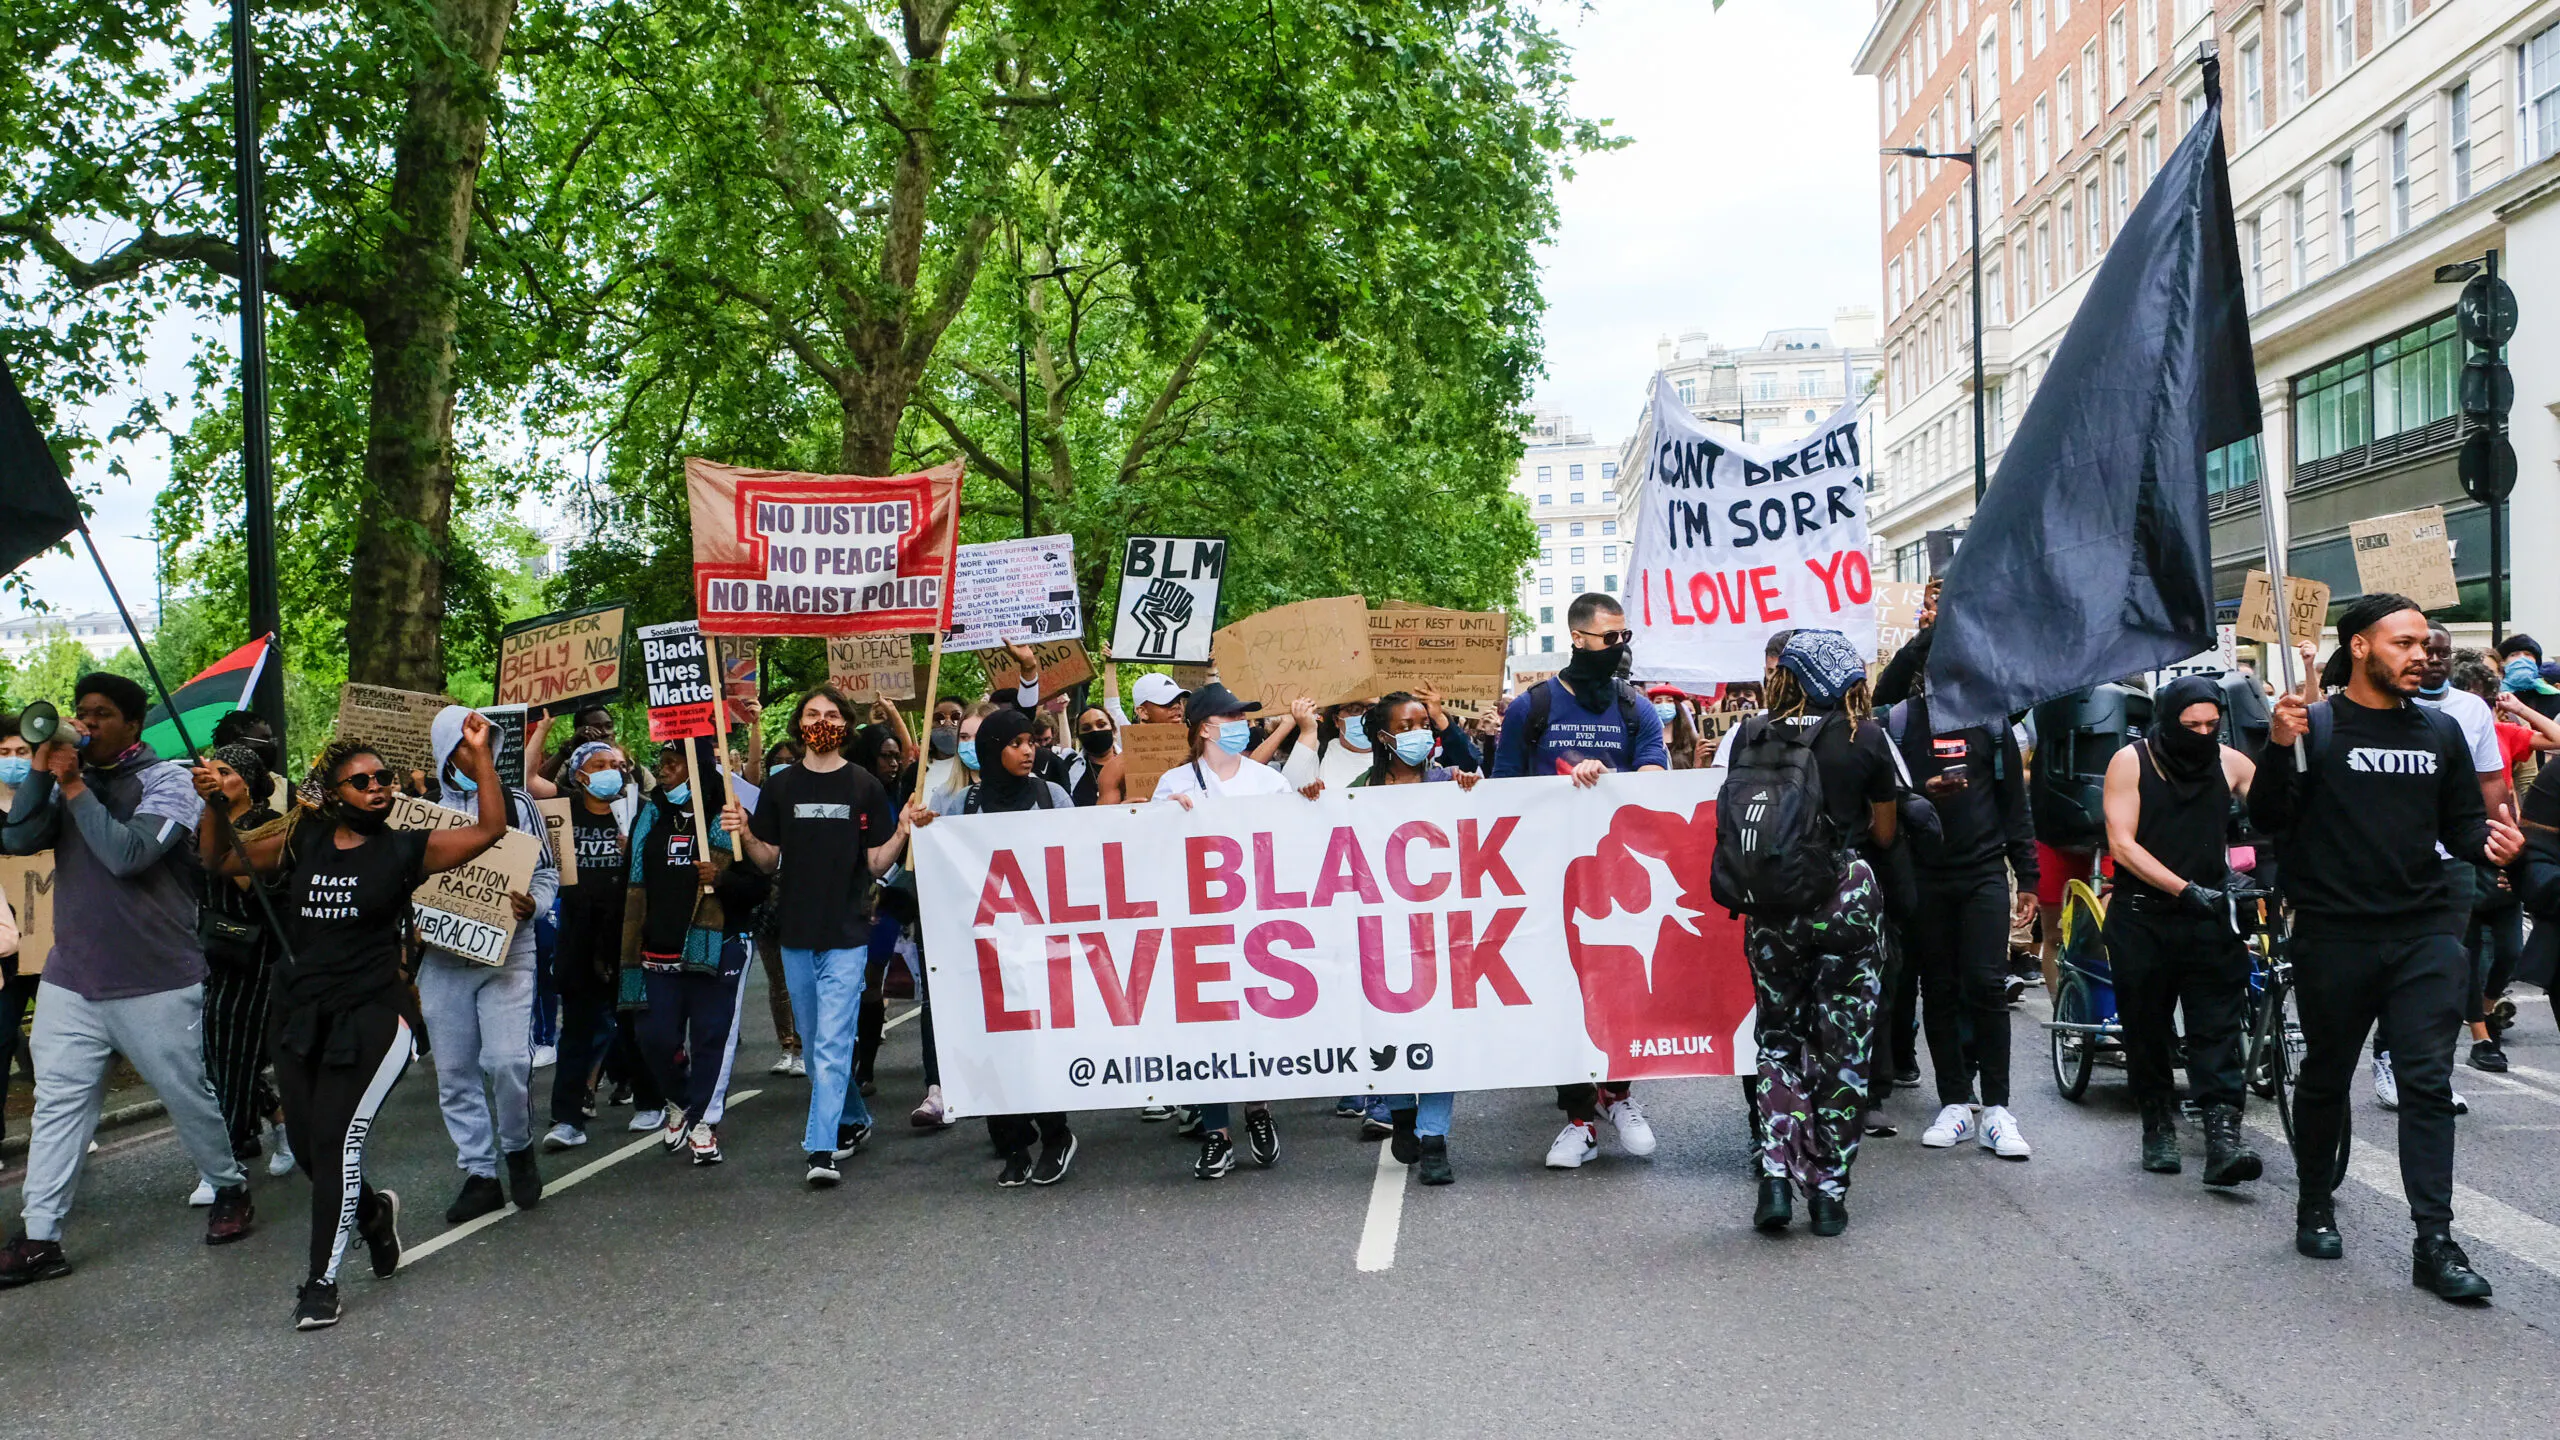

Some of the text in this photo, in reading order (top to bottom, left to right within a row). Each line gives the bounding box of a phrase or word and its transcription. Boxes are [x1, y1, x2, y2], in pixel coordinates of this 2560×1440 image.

[758, 503, 910, 535] NO JUSTICE
[1669, 476, 1864, 550] I'M SORR
[2358, 534, 2388, 550] BLACK
[770, 544, 896, 575] NO PEACE
[960, 560, 982, 568] MORE
[986, 558, 1009, 566] WHEN
[1125, 539, 1223, 580] BLM
[972, 576, 1004, 584] THROUGH
[712, 578, 941, 615] NO RACIST POLIC
[1642, 550, 1872, 627] I LOVE YO
[968, 601, 990, 609] BLACK
[1902, 588, 1924, 606] IS
[995, 605, 1020, 613] RACISM
[2289, 603, 2319, 618] NOT
[651, 624, 699, 637] Socialist Work
[983, 620, 1019, 629] PROBLEM
[1395, 618, 1420, 630] NOT
[1425, 617, 1454, 630] REST
[1460, 619, 1497, 632] UNTIL
[507, 615, 600, 655] JUSTICE FOR
[971, 638, 994, 646] MATTER
[1371, 638, 1409, 648] TEMIC
[1418, 638, 1455, 647] RACISM
[585, 635, 621, 661] NOW
[643, 636, 705, 662] Black
[831, 639, 911, 662] NO PEACE
[503, 641, 569, 683] BELLY
[863, 661, 883, 669] THERE
[1040, 645, 1071, 671] AND
[1278, 658, 1325, 674] SMALL
[646, 662, 701, 684] Lives
[500, 667, 591, 706] MUJINGA
[831, 671, 911, 692] RACIST POLICE
[348, 686, 405, 701] IMPERIALISM
[649, 681, 718, 706] Matte
[355, 698, 411, 713] EXPLOITATION
[652, 708, 706, 719] Smash racism
[373, 724, 419, 734] IMPERIALISM
[655, 728, 693, 737] necessary
[1581, 724, 1596, 732] THE
[1597, 725, 1621, 733] TRUTH
[401, 746, 418, 754] THAT
[1549, 740, 1557, 748] IF
[1595, 741, 1621, 749] ALONE
[2356, 752, 2430, 774] NOIR
[396, 797, 443, 829] TISH
[574, 840, 622, 856] IVE
[667, 858, 691, 866] FILA
[973, 816, 1526, 928] ALL BLACK
[311, 874, 358, 887] BLACK
[308, 890, 352, 903] LIVES
[438, 875, 510, 907] RACIST
[301, 906, 359, 919] MATTER
[428, 895, 509, 926] RACIST STATE
[435, 914, 502, 956] RACIST
[649, 964, 680, 973] FILA
[974, 906, 1533, 1033] LIVES UK
[1629, 1035, 1714, 1058] #ABLUK
[339, 1116, 373, 1234] TAKE THE RISK
